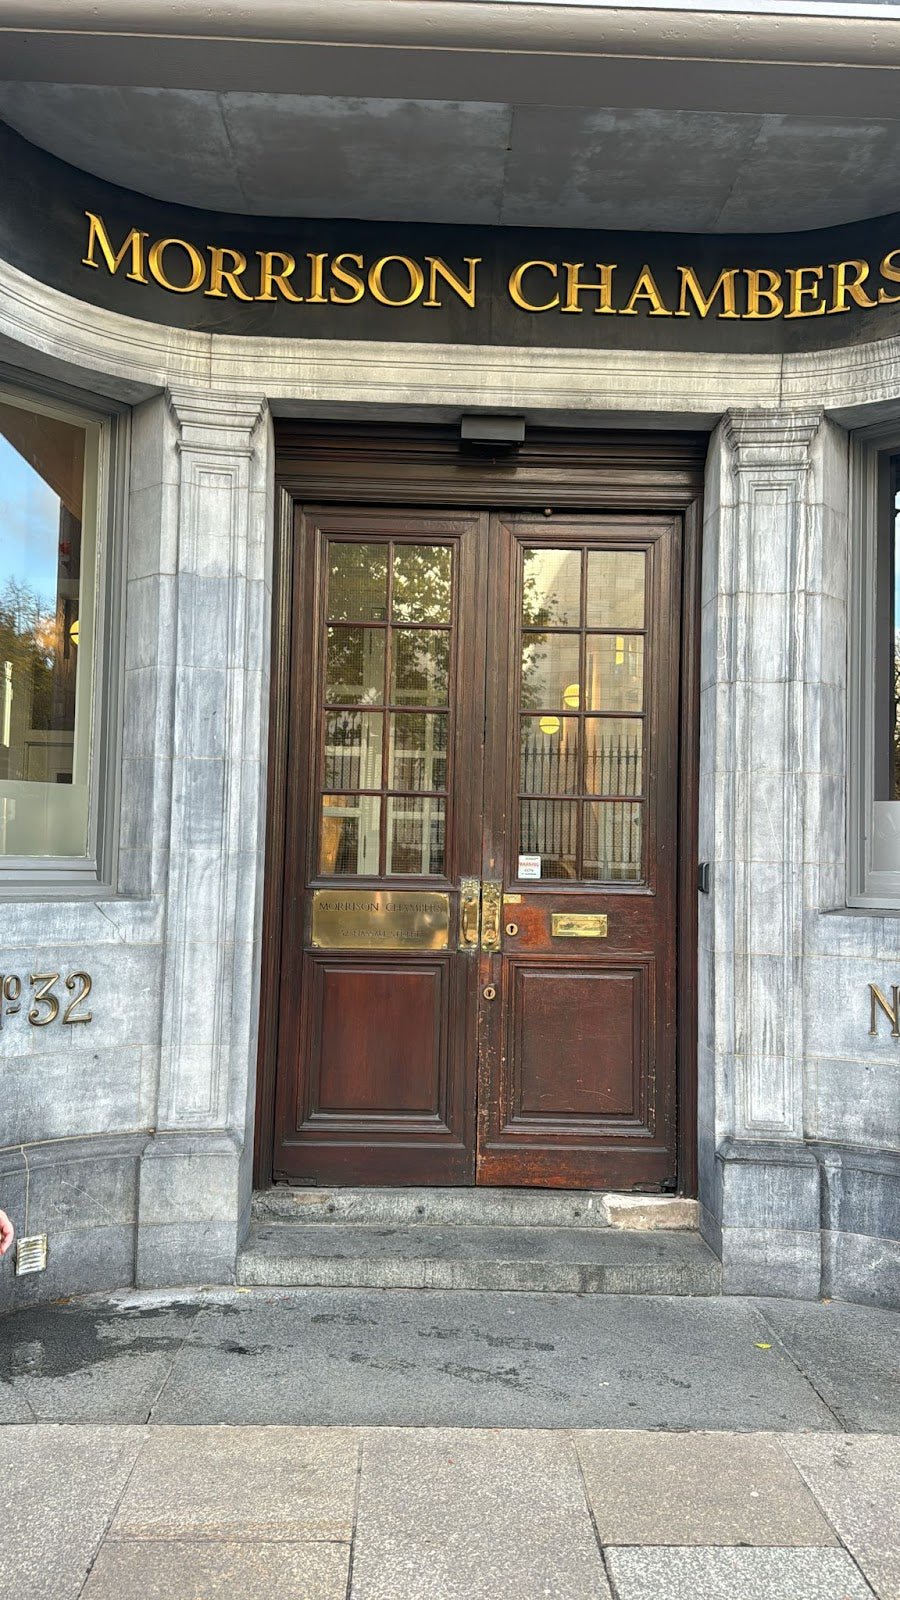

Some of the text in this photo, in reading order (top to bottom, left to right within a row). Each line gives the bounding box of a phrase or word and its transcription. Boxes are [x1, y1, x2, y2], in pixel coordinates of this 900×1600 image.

[81, 210, 900, 319] MORRISON CHAMBERS
[319, 902, 379, 912] MORRISON
[28, 970, 93, 1027] 32
[868, 983, 900, 1037] N
